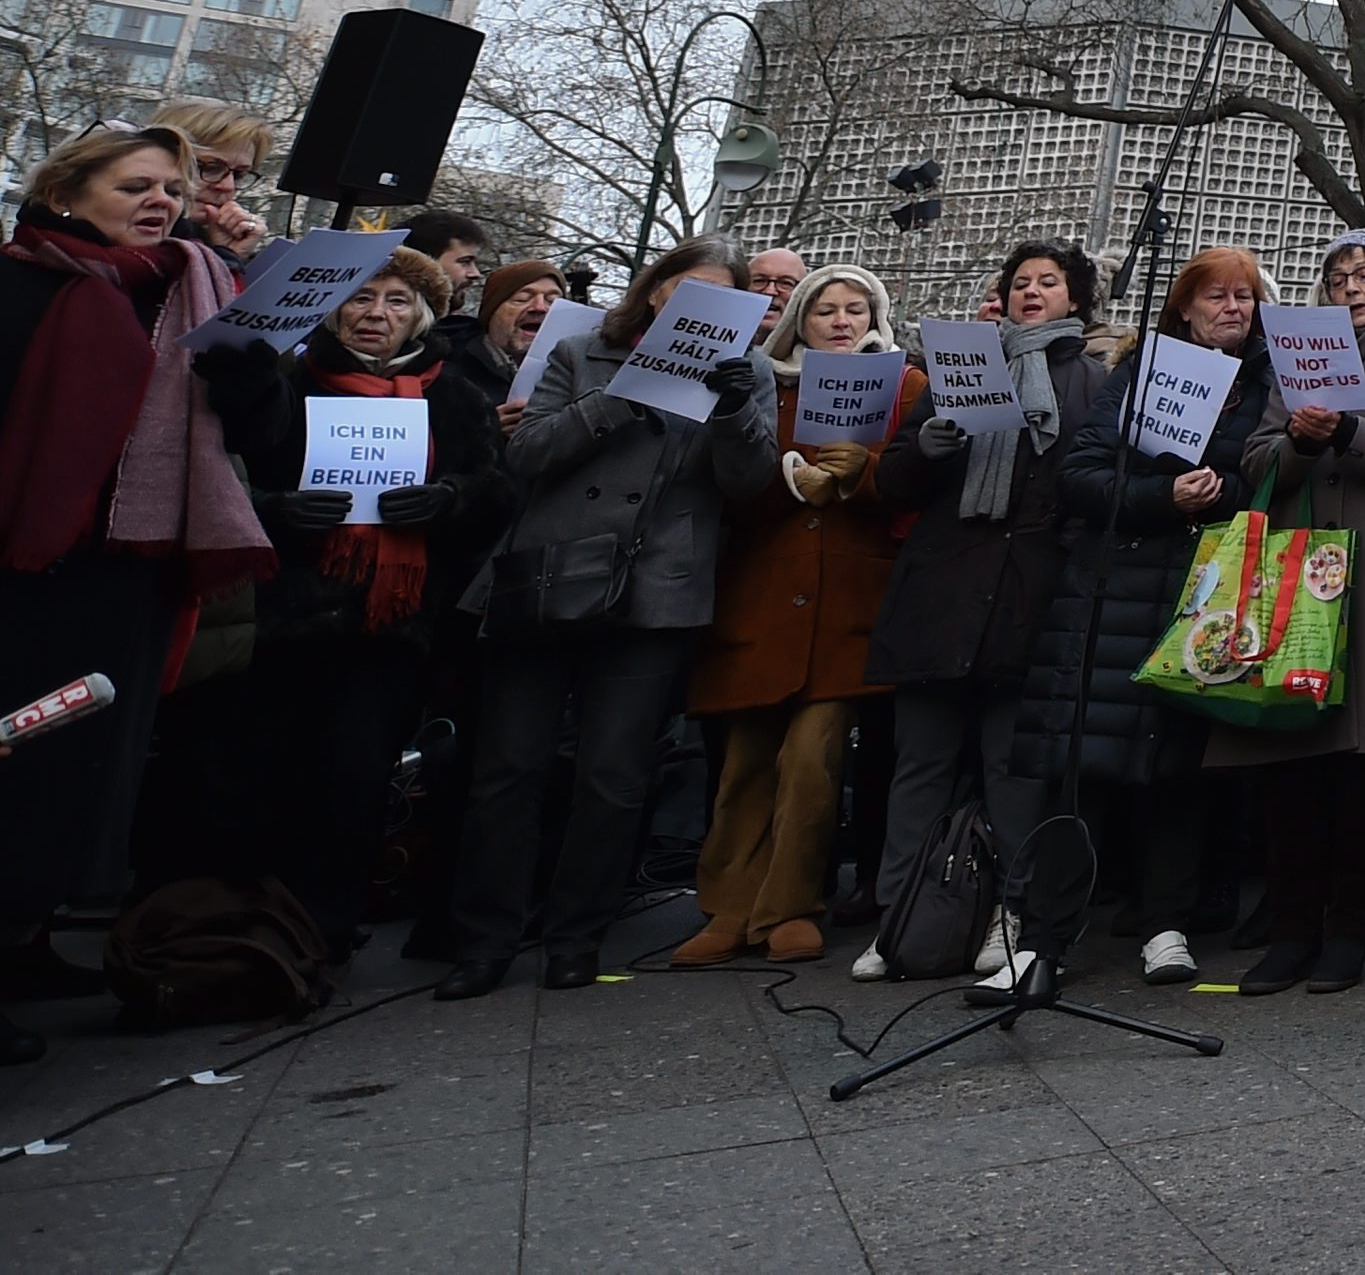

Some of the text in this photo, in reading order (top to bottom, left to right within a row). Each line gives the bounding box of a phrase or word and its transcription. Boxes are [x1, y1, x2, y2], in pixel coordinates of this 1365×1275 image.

[288, 266, 362, 284] BERLIN
[275, 288, 332, 307] HÄLT
[672, 317, 739, 344] BERLIN
[668, 339, 719, 362] HÄLT
[1271, 334, 1349, 351] YOU WILL
[934, 351, 987, 367] BERLIN
[1295, 358, 1329, 371] NOT
[628, 353, 712, 384] ZUSAMM
[818, 378, 884, 392] ICH BIN
[944, 370, 983, 387] HÄLT
[1150, 369, 1211, 400] ICH BIN
[1281, 374, 1360, 390] DIVIDE US
[832, 397, 862, 409] EIN
[932, 391, 1014, 408] ZUSAMMEN
[1156, 396, 1185, 417] EIN
[803, 409, 886, 427] BERLINER
[330, 425, 406, 440] ICH BIN
[350, 446, 385, 461] EIN
[310, 469, 416, 485] BERLINER
[16, 685, 88, 727] RMC
